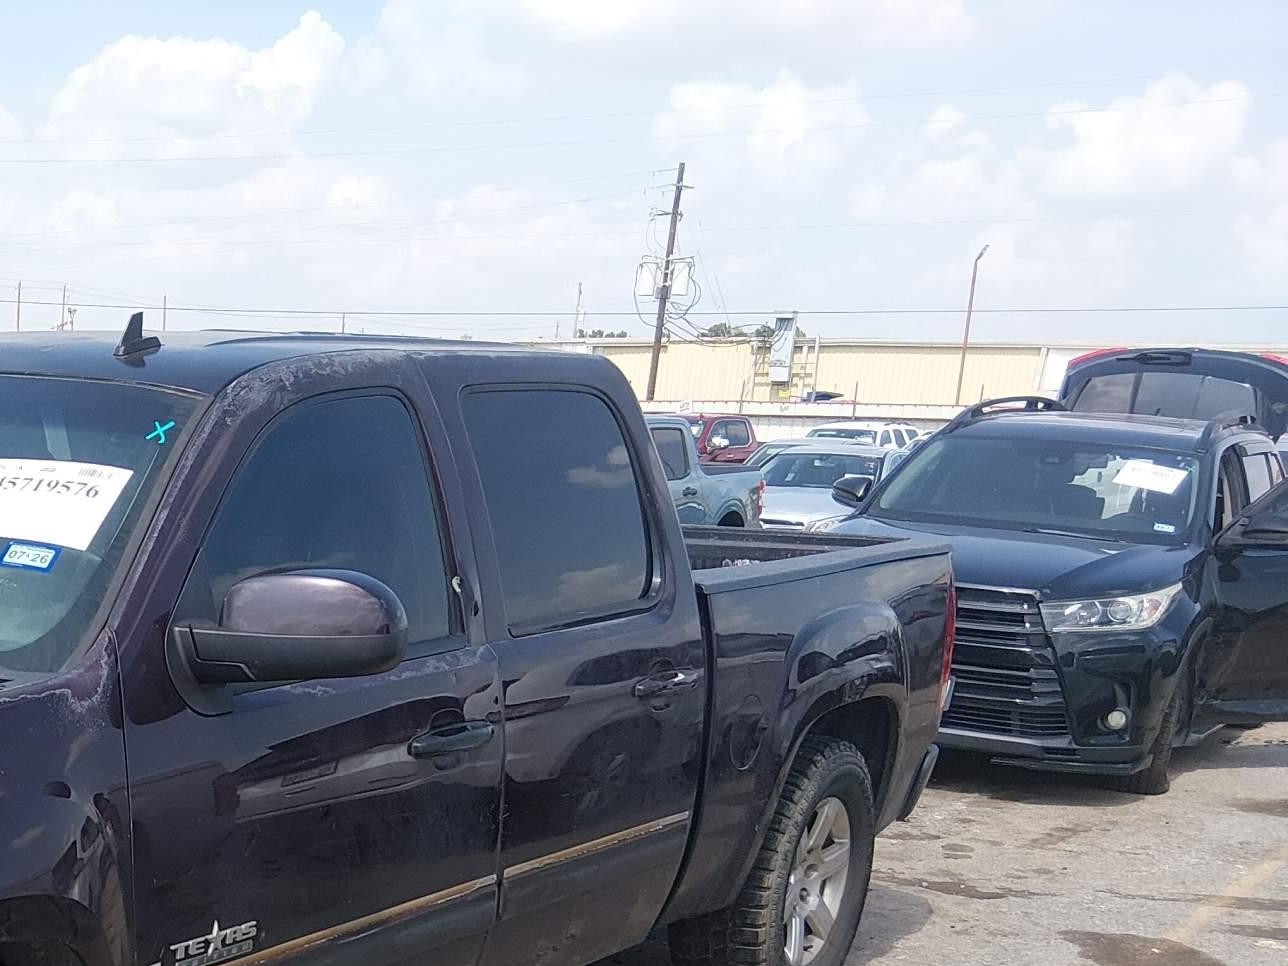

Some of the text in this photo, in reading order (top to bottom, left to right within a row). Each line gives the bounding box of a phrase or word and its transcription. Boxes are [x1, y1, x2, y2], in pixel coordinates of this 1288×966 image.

[8, 550, 26, 560] 07
[29, 553, 50, 564] 26
[170, 920, 257, 960] TEXAS
